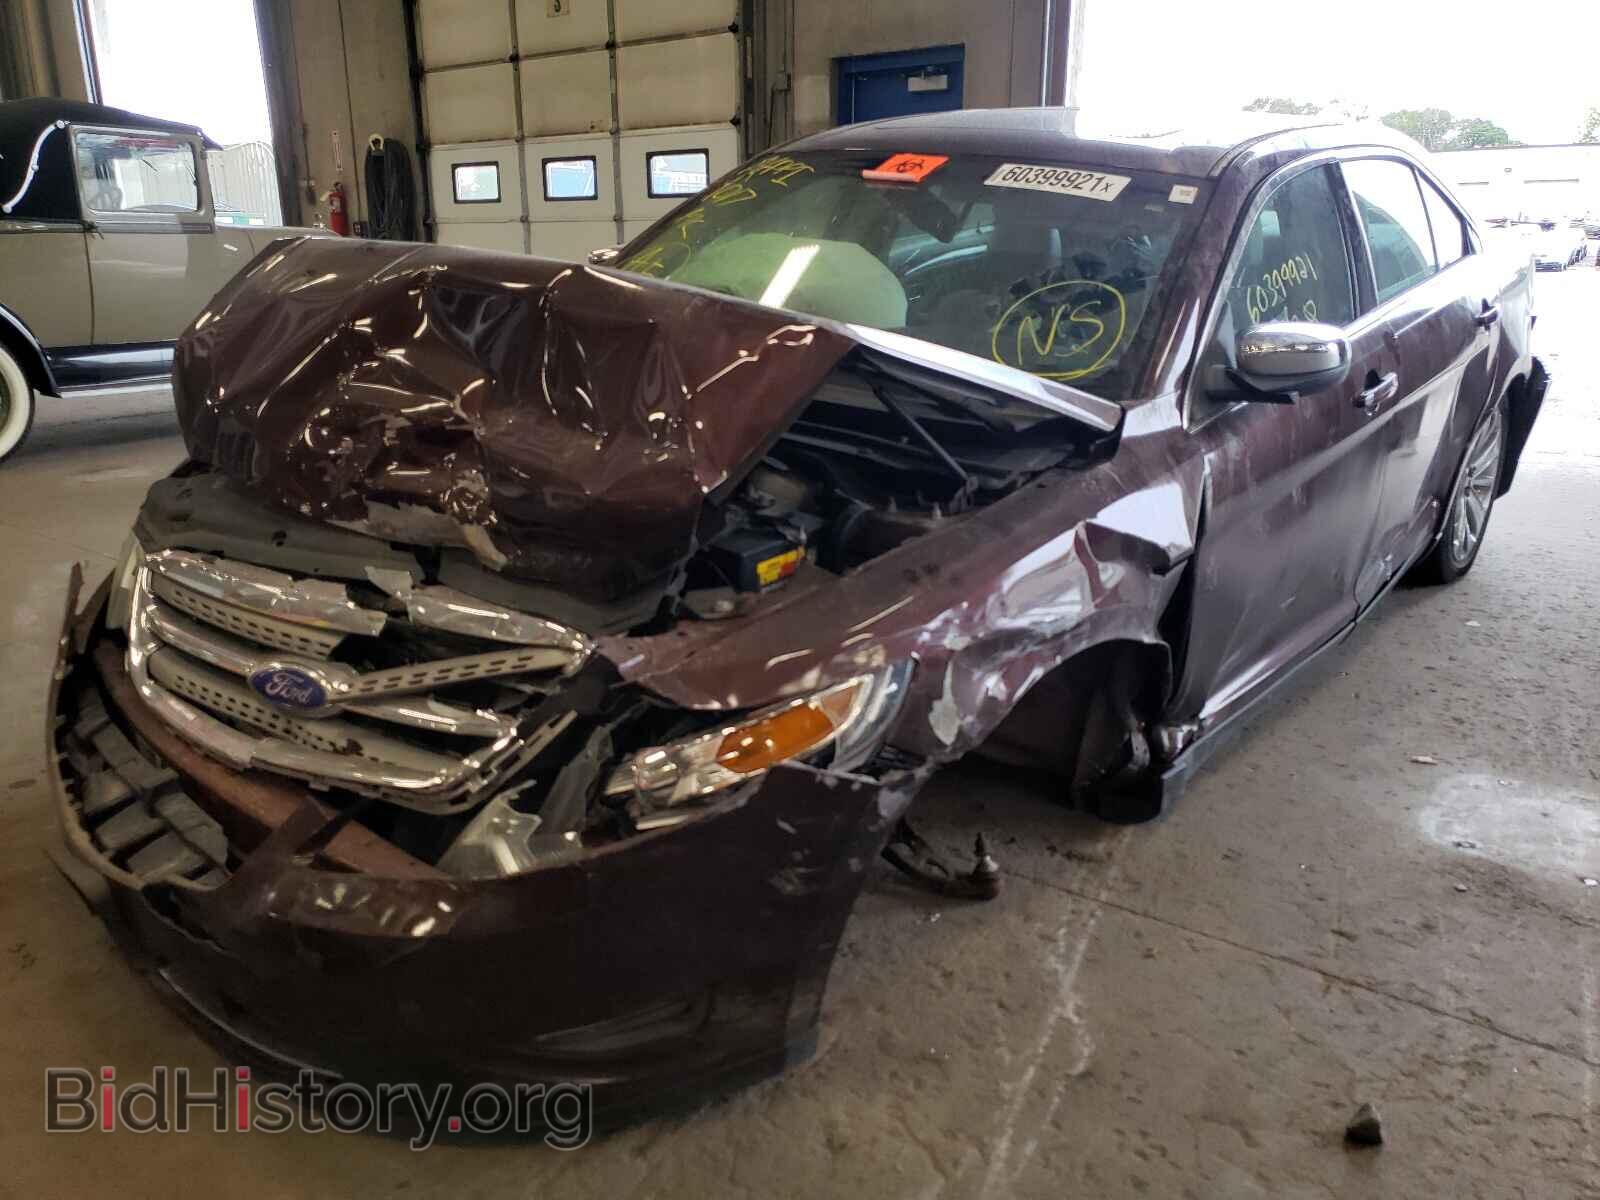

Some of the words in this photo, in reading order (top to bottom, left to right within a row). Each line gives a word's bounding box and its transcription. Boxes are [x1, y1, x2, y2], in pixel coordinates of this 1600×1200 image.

[1247, 251, 1318, 324] 60399921
[1017, 301, 1104, 365] NS
[265, 672, 313, 704] Ford
